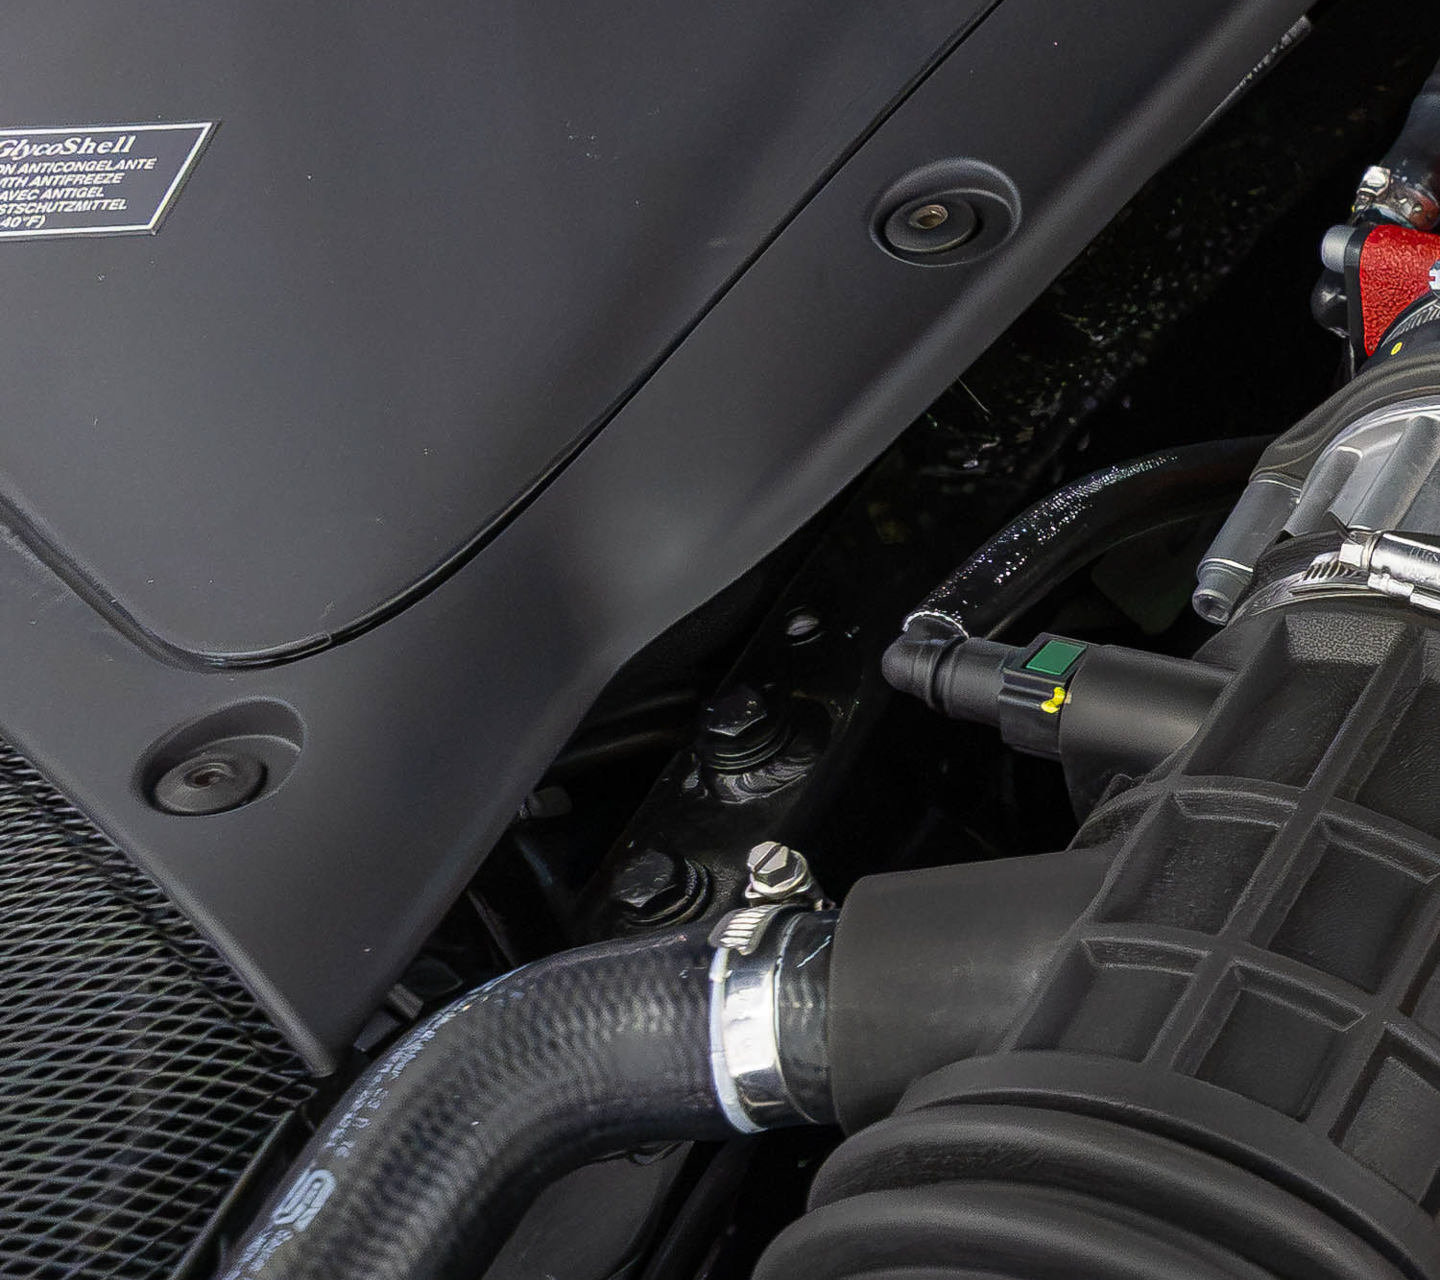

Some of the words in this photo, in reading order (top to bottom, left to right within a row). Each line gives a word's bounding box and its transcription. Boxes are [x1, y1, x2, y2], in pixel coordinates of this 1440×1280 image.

[0, 135, 136, 161] GlycoShell
[17, 158, 157, 174] ANTICONGELANTE
[28, 172, 125, 187] ANTIFREEZE
[1, 188, 40, 202] AVEC
[37, 186, 104, 200] ANTIGEL
